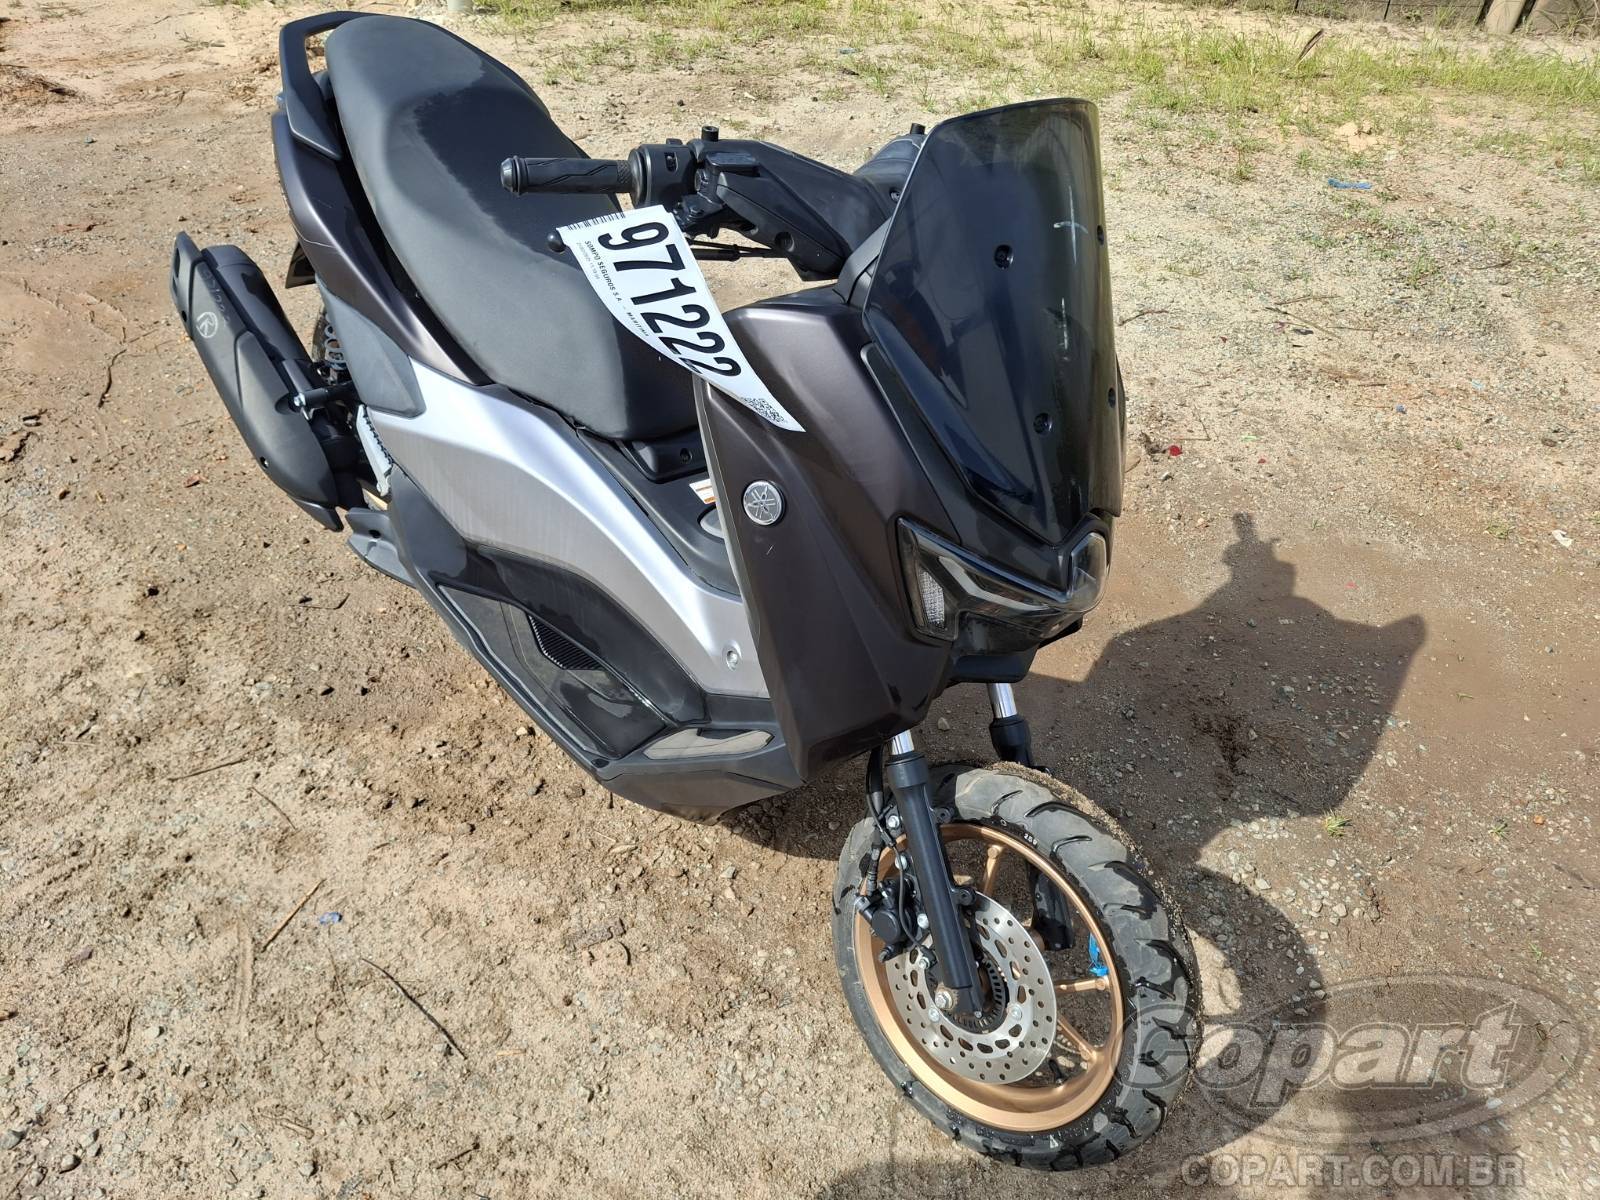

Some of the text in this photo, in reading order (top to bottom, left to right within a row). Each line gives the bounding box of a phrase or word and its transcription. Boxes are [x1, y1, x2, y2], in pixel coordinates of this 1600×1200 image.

[584, 240, 601, 260] SOMPO
[597, 260, 616, 291] SEGUROS
[597, 221, 742, 377] 971222
